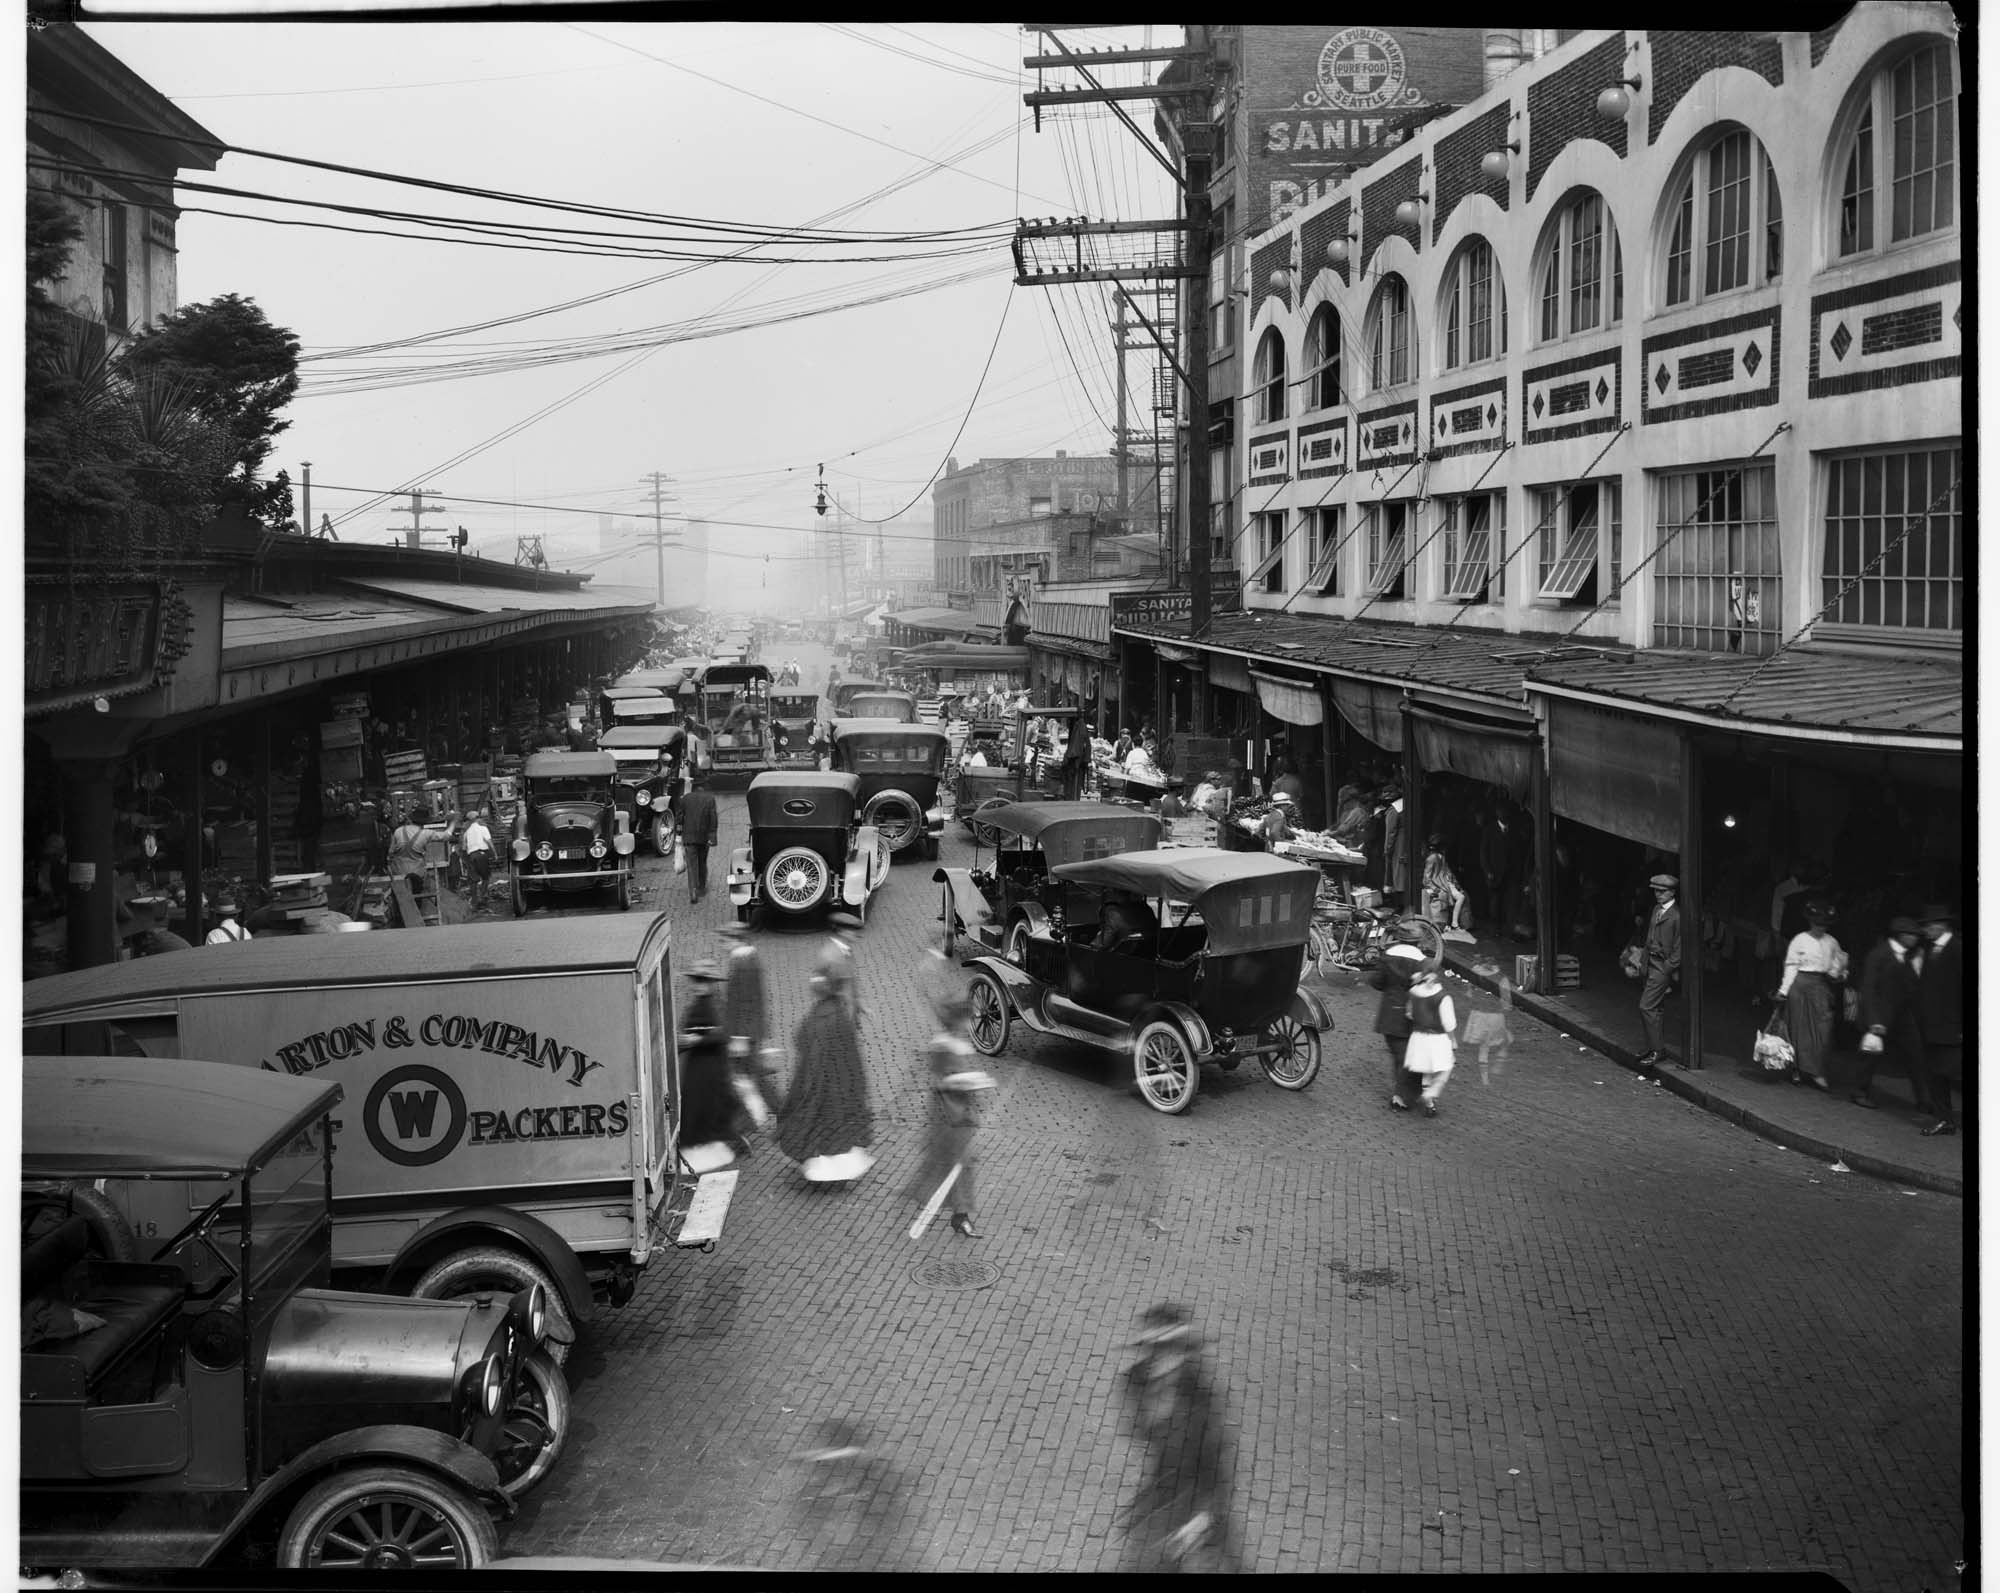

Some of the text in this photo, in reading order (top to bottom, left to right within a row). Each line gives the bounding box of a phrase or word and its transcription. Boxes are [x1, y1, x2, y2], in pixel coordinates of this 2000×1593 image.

[1320, 28, 1402, 85] SANITARY PUBLIC MARKET
[1337, 63, 1386, 73] PURE FOOD
[1334, 91, 1387, 107] SEATTLE
[1267, 118, 1404, 151] SANITA
[1138, 598, 1192, 611] SANITA
[382, 1015, 415, 1049] &
[419, 1014, 605, 1088] COMPANY
[389, 1089, 439, 1139] W
[467, 1100, 630, 1146] PACKERS
